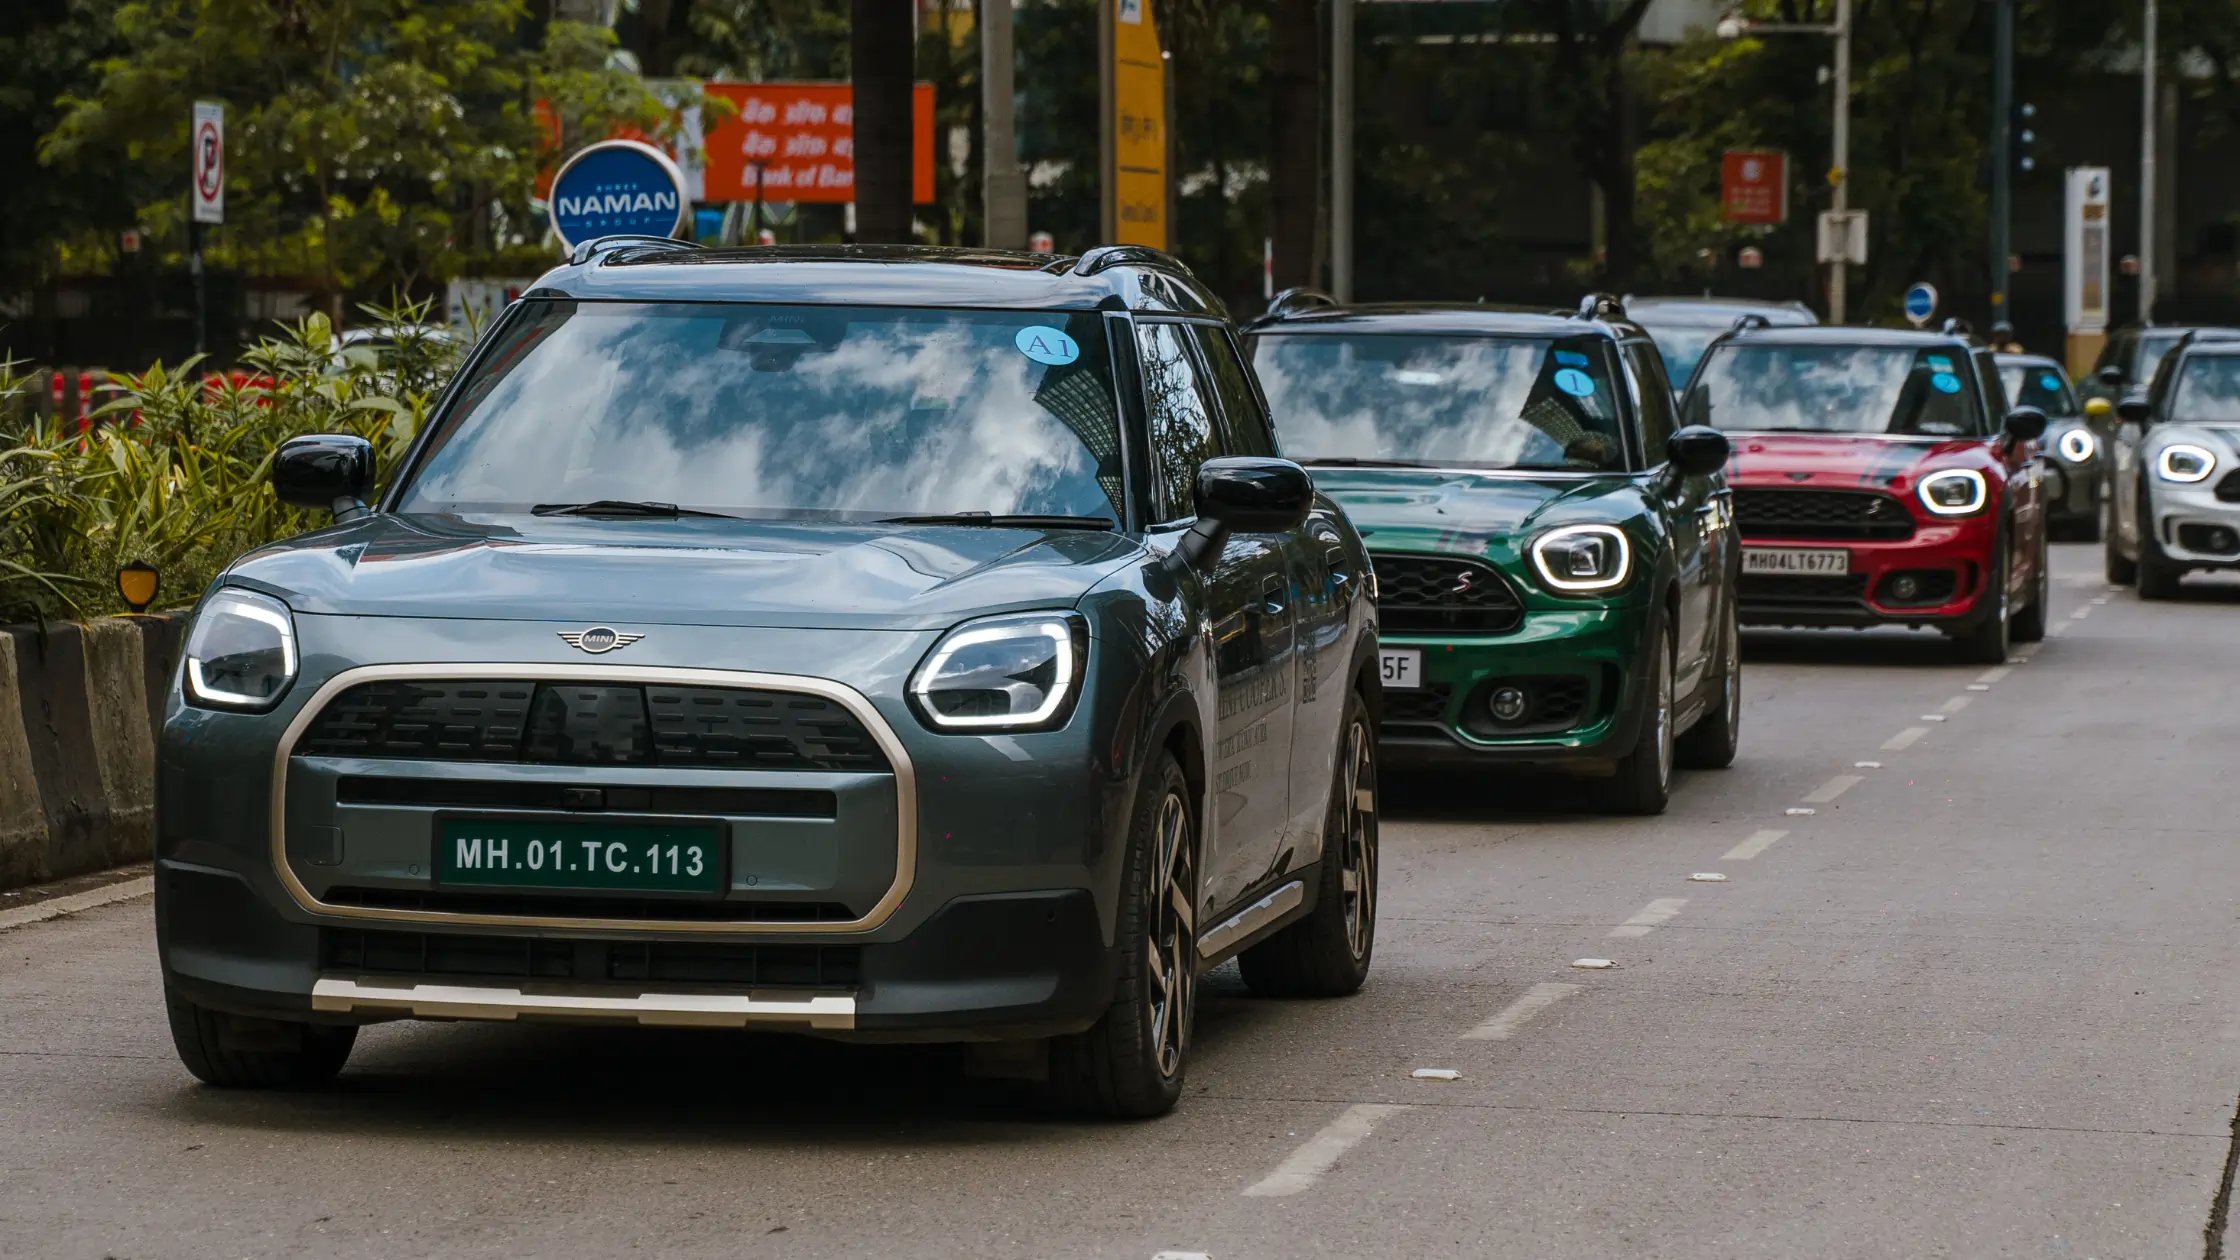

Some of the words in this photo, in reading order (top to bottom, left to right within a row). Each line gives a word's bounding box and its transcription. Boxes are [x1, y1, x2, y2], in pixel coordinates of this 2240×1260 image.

[795, 164, 818, 188] of
[559, 191, 677, 216] NAMAN
[769, 315, 805, 323] MINI
[1026, 334, 1074, 358] A1
[1569, 374, 1581, 392] 1
[1749, 553, 1846, 572] MH04LT6773
[1452, 571, 1473, 593] S
[584, 634, 614, 643] MINI
[1382, 656, 1410, 680] 5F
[456, 838, 704, 876] MH.01.TC.113
